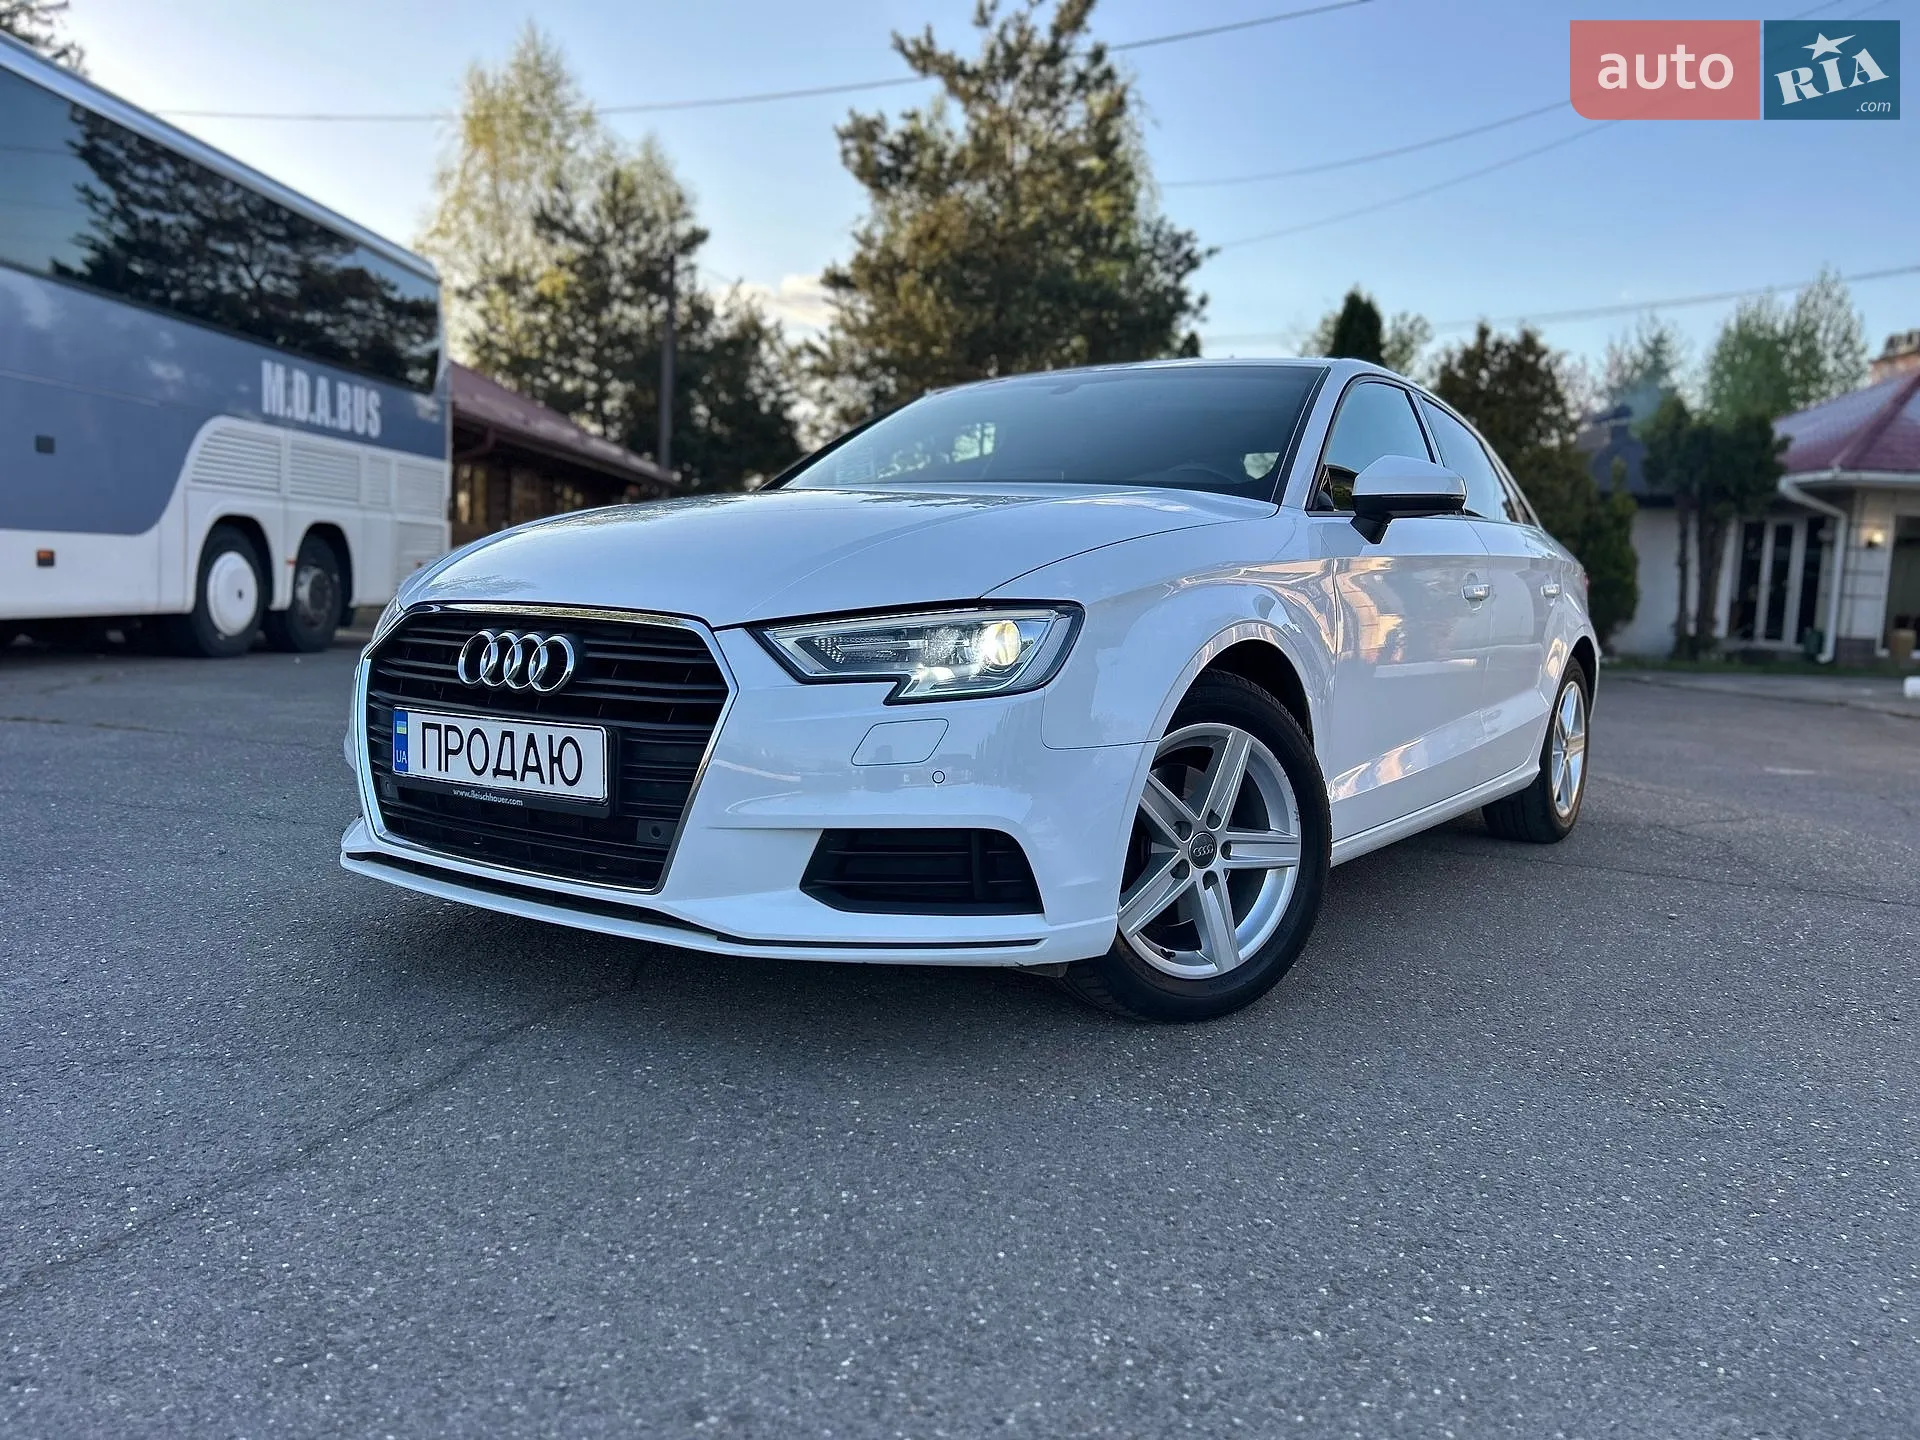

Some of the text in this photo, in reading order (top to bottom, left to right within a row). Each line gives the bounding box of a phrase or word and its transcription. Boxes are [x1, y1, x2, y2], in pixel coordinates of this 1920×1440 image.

[261, 360, 381, 438] M.D.A.BUS
[396, 750, 407, 764] UA
[421, 722, 582, 786] ПРОДАЮ
